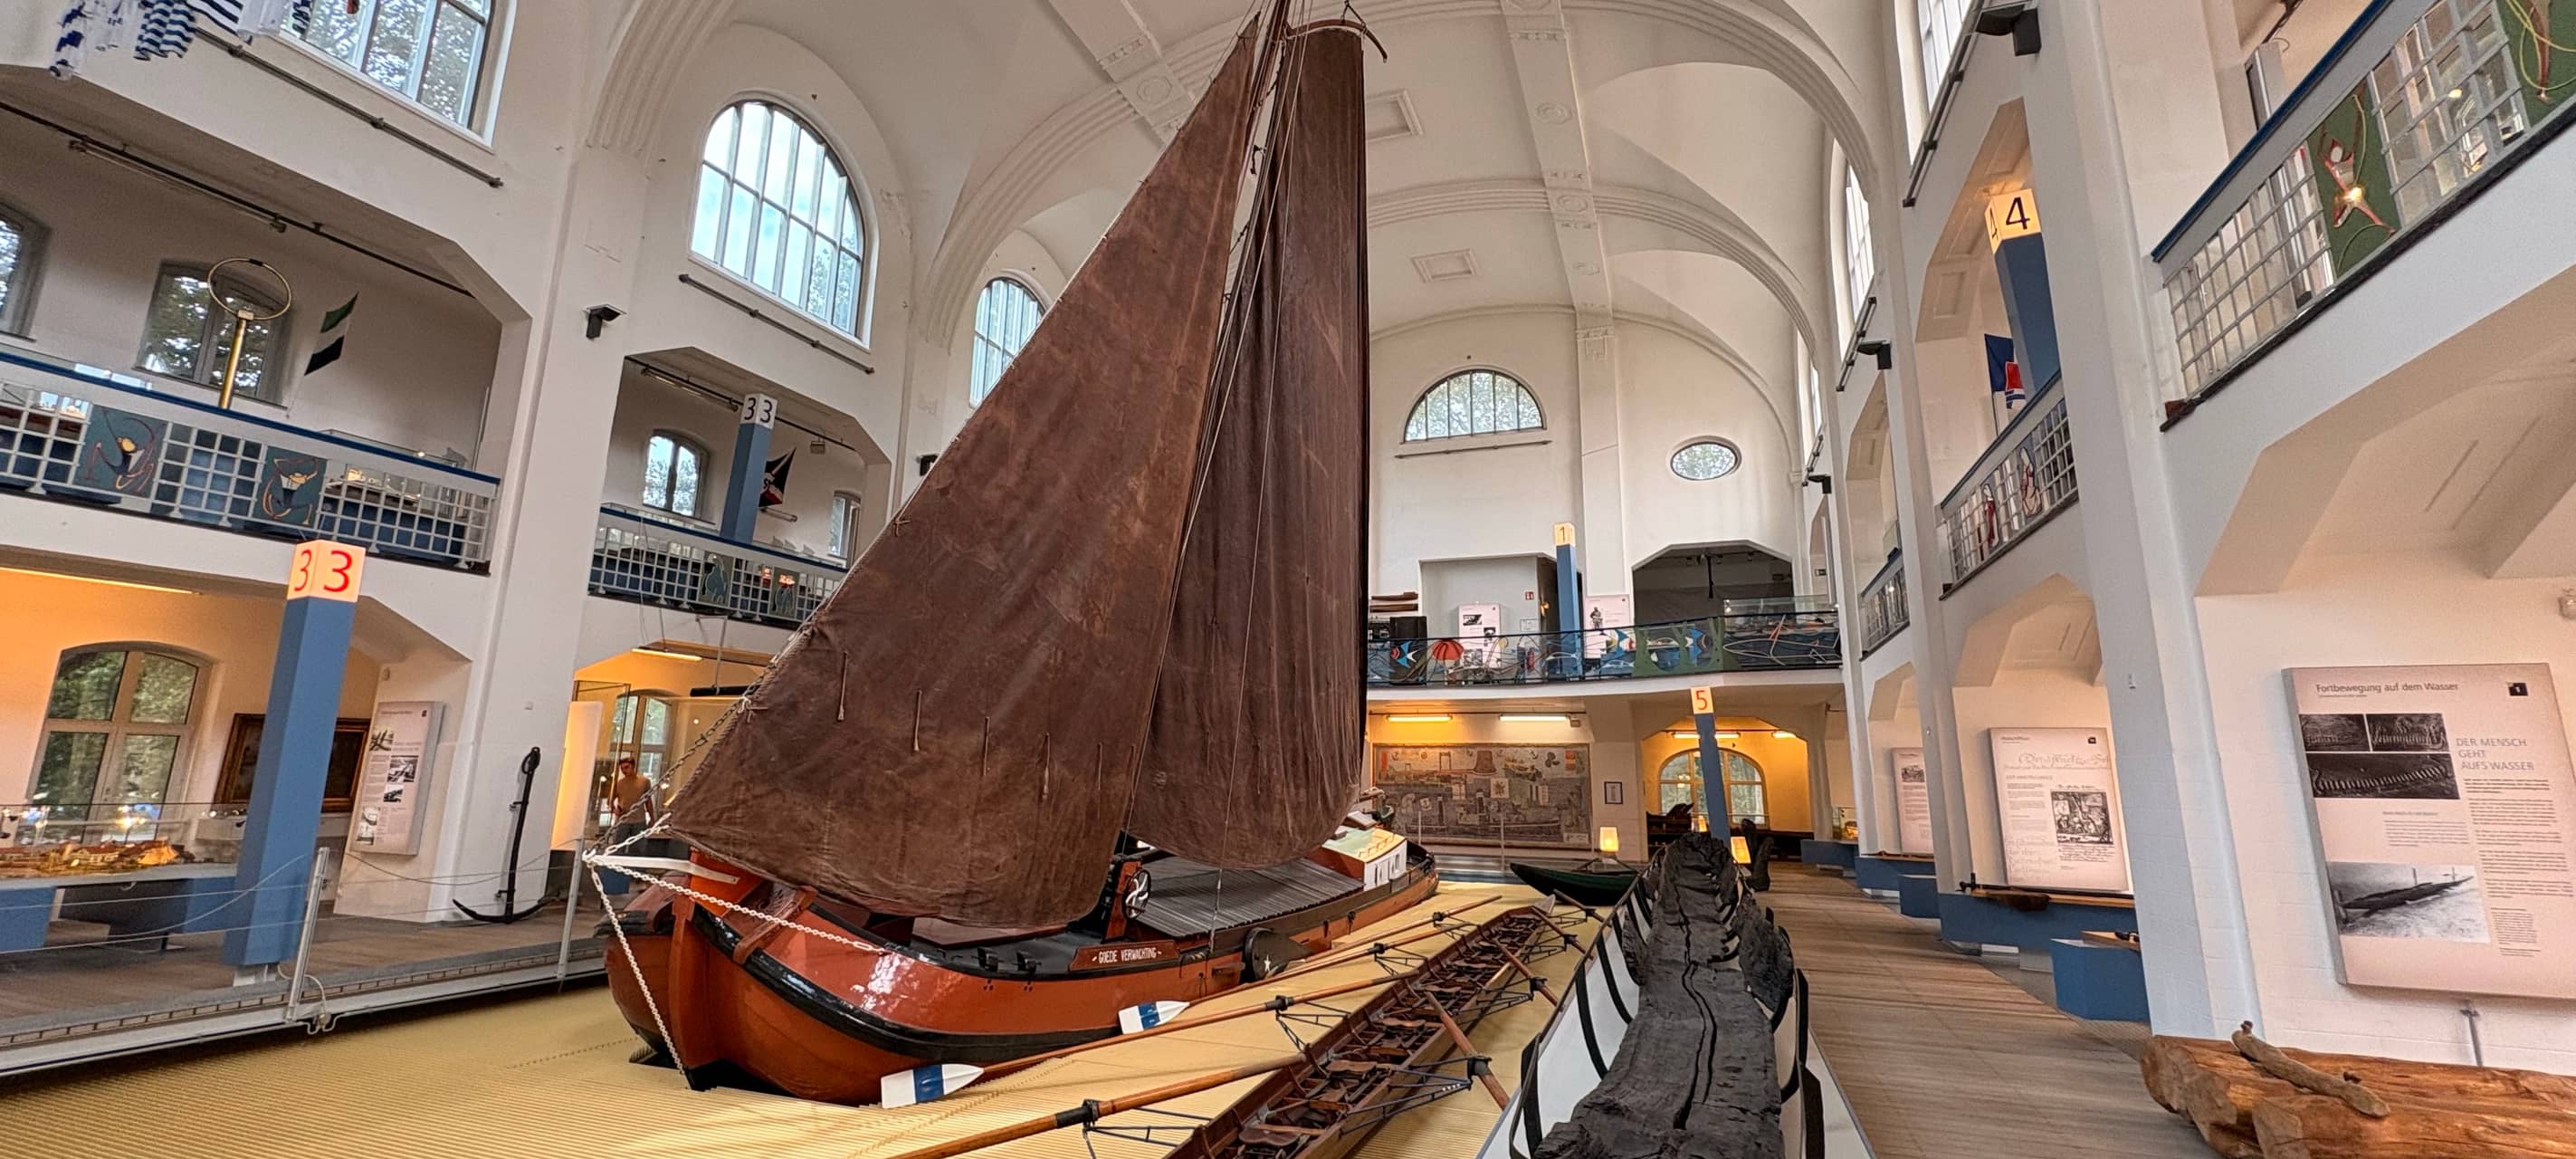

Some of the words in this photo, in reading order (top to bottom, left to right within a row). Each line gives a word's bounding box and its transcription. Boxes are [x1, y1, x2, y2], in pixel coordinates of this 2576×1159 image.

[2006, 196, 2030, 230] 4
[744, 398, 757, 420] 3
[760, 399, 773, 423] 3
[1560, 526, 1565, 542] 1
[294, 549, 312, 592] 3
[323, 550, 353, 593] 3
[2315, 684, 2382, 694] Fortbewegung
[2384, 683, 2399, 692] auf
[2399, 683, 2422, 691] dem
[2424, 683, 2458, 691] Wasser
[1695, 690, 1708, 711] 5
[2456, 738, 2478, 747] DER
[2480, 738, 2527, 747] MENSCH
[2458, 749, 2486, 758] GEHT
[2461, 761, 2488, 771] AUFS
[2490, 761, 2534, 771] WASSER
